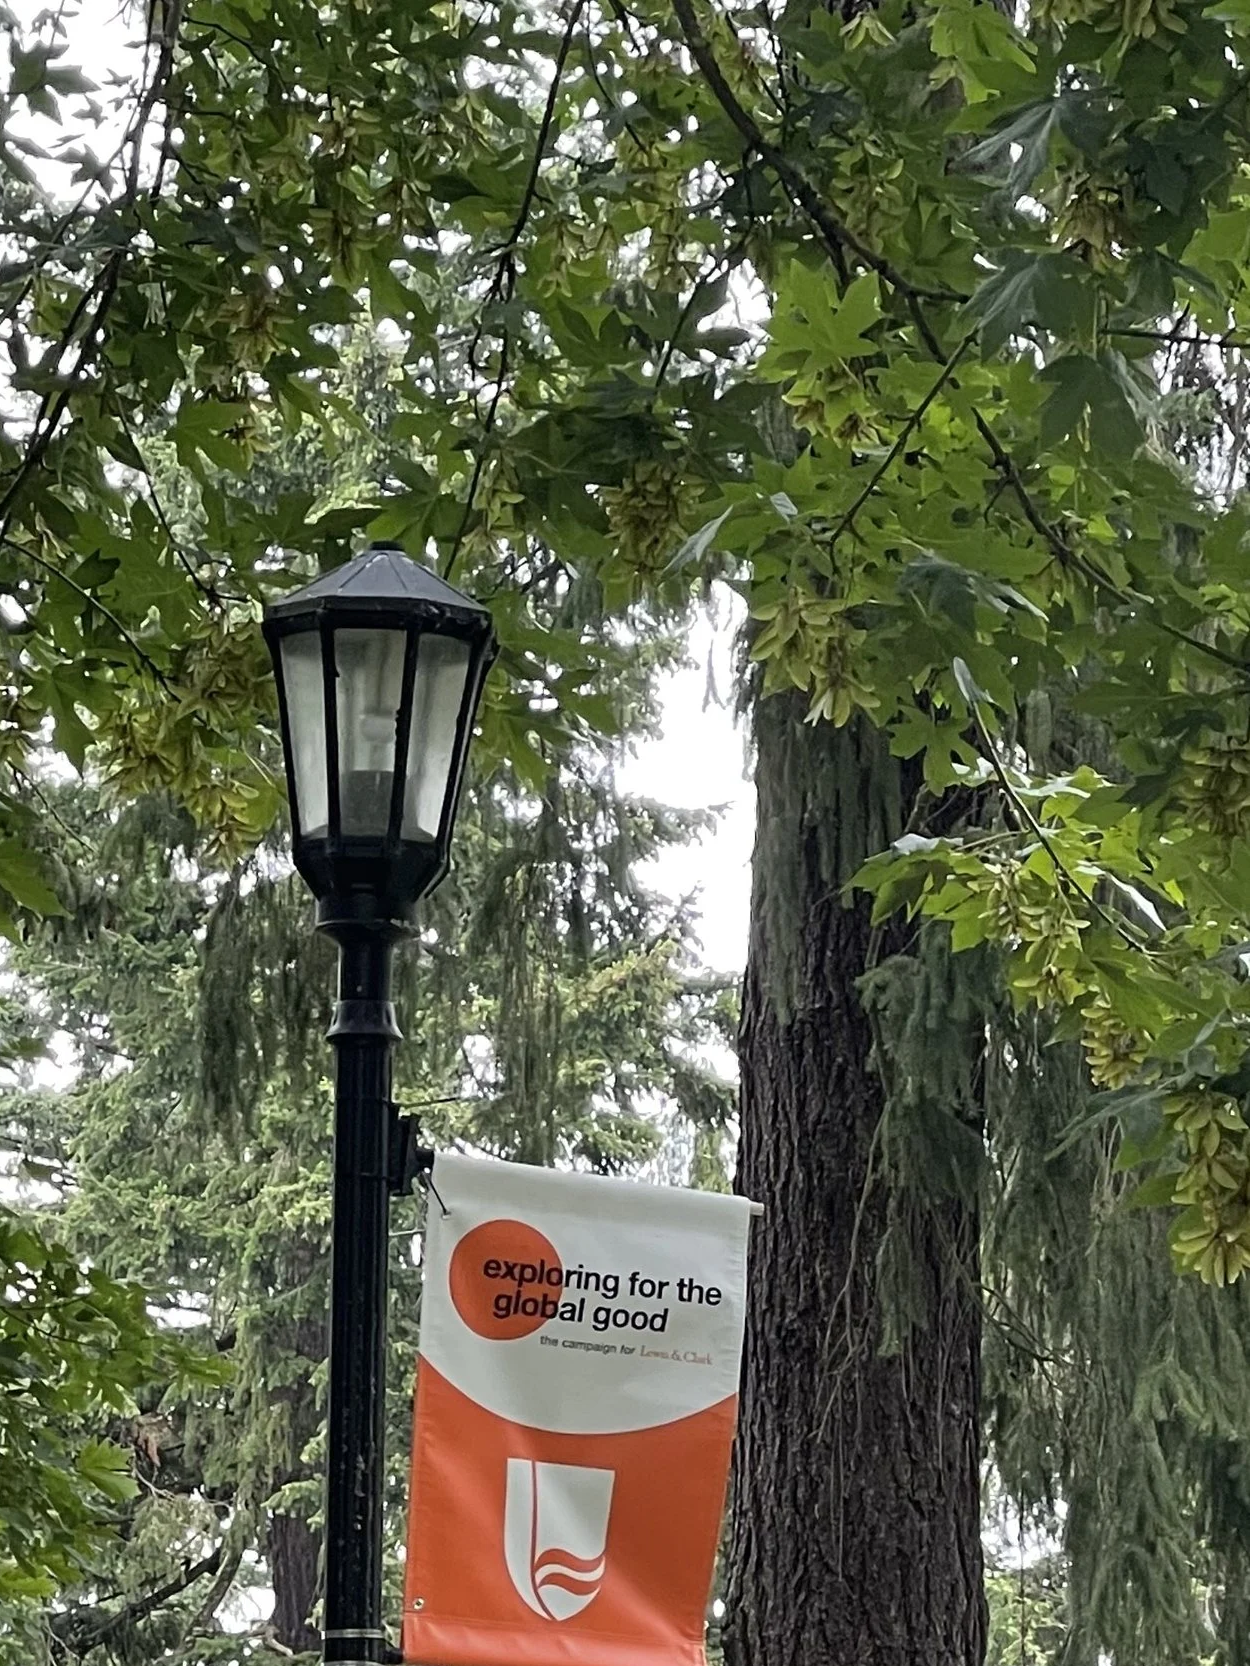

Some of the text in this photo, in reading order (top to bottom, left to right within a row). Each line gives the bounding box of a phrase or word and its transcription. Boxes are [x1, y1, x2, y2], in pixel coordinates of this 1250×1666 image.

[483, 1258, 722, 1306] exploring for the
[493, 1289, 669, 1332] global good
[540, 1335, 558, 1347] the
[562, 1339, 616, 1355] campaign
[620, 1344, 636, 1355] for
[671, 1349, 682, 1362] &
